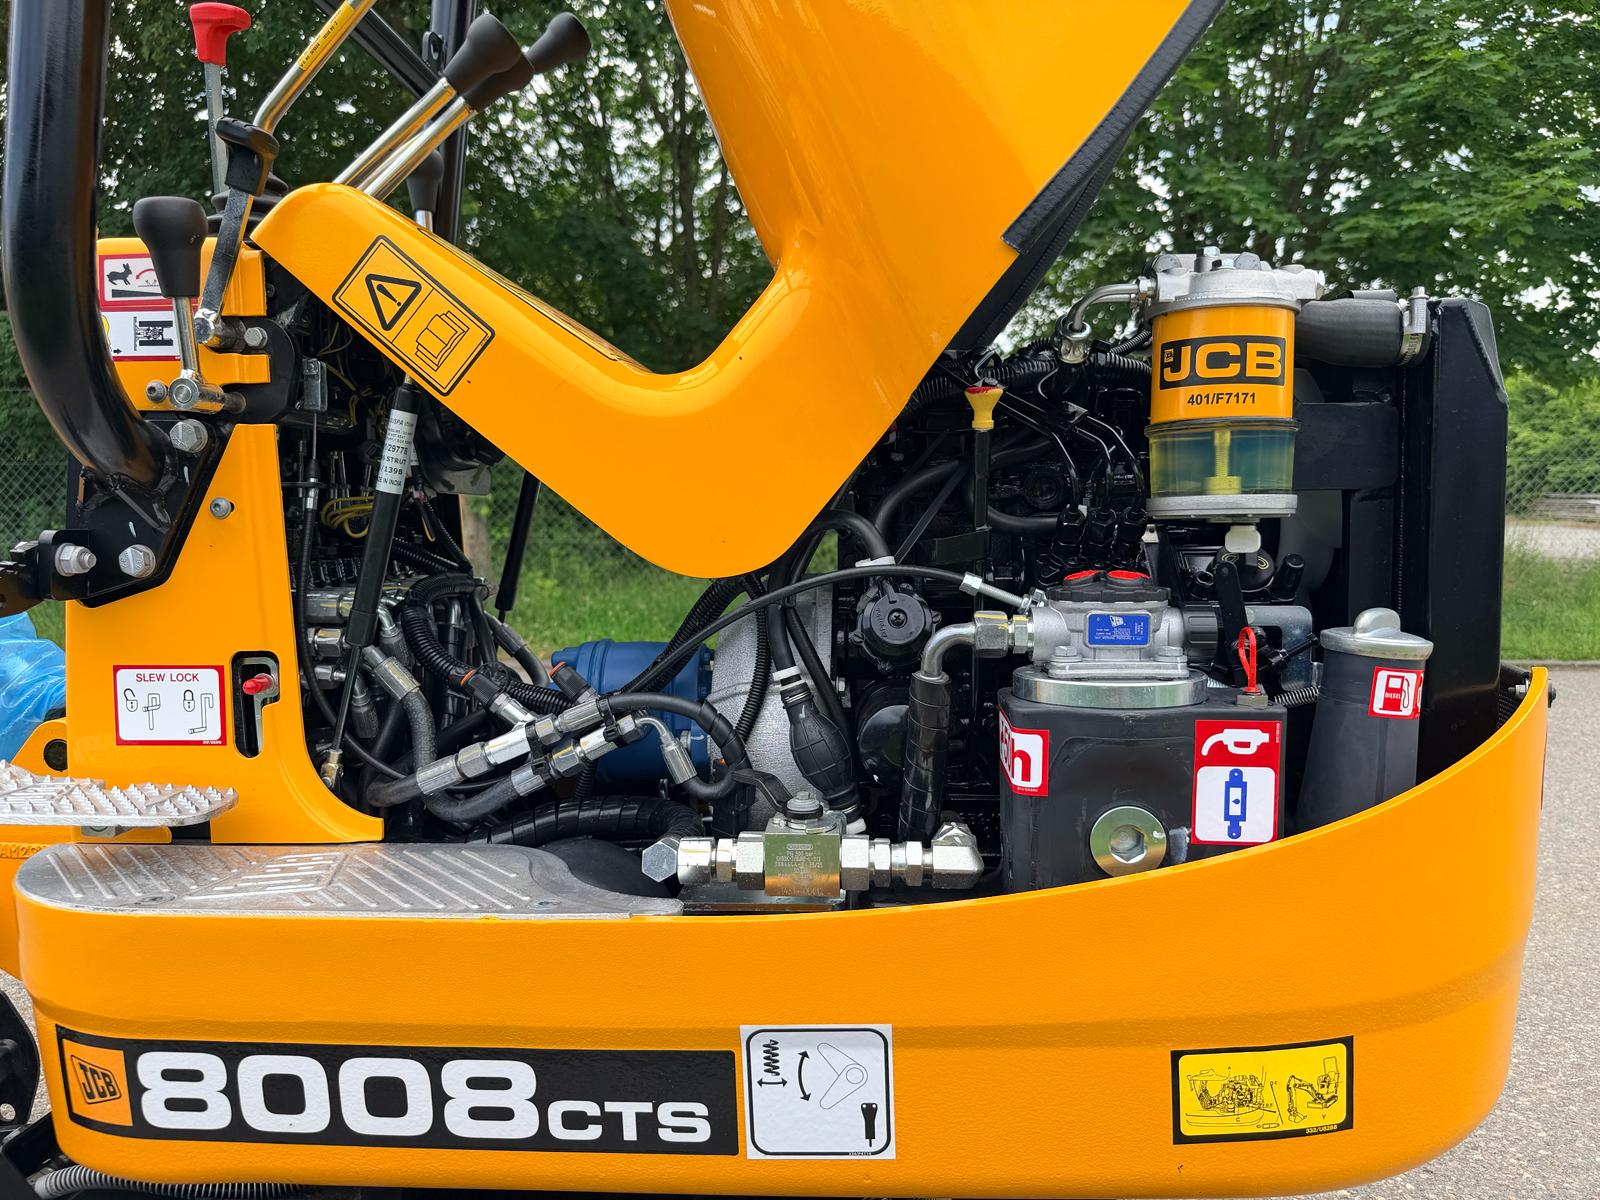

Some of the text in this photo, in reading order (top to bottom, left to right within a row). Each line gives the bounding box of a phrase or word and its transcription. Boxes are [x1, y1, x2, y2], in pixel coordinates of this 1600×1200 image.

[1163, 342, 1281, 382] JCB
[1187, 392, 1256, 405] 401/F7171
[386, 456, 407, 465] STRUT
[135, 673, 200, 682] SLEW LOCK
[78, 1062, 118, 1100] JCB
